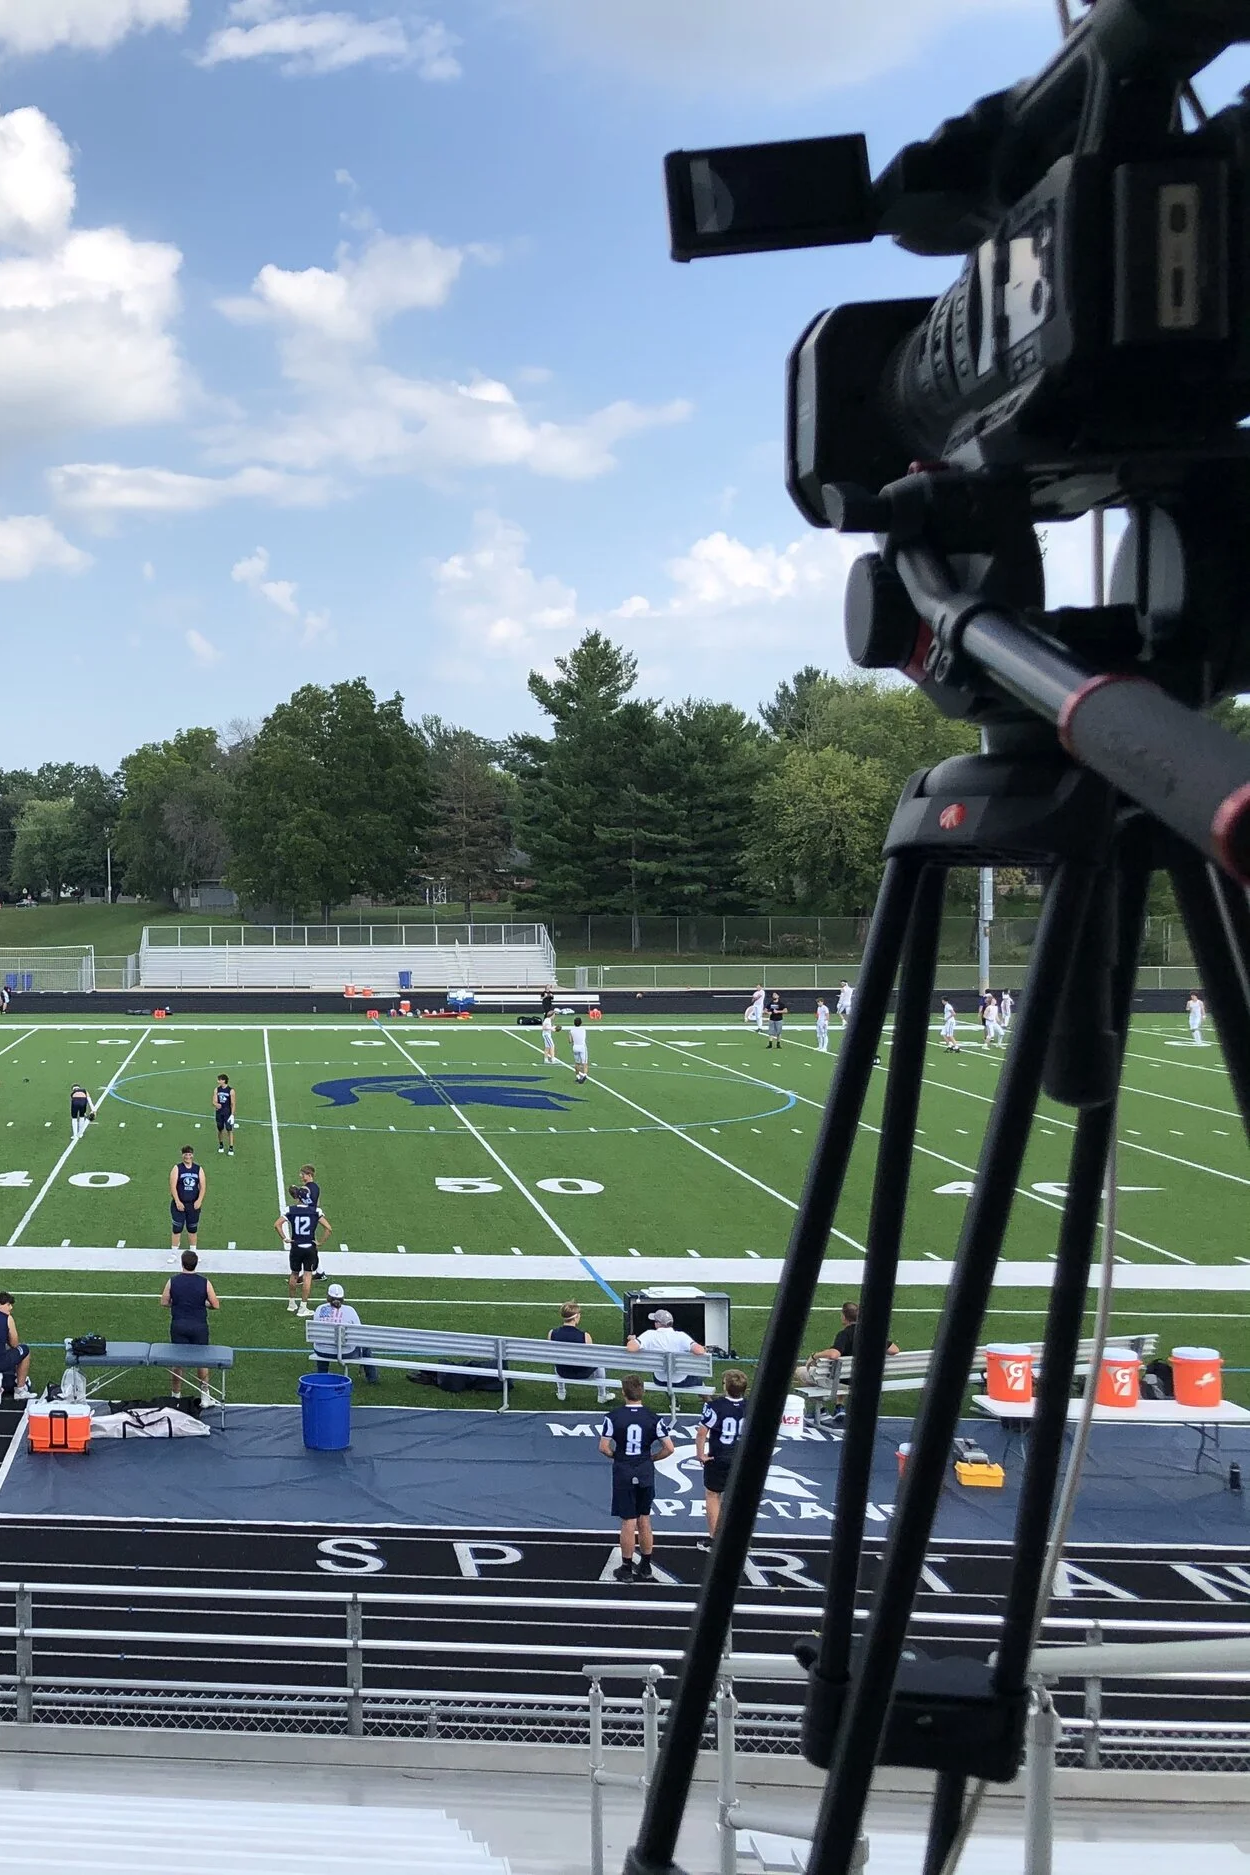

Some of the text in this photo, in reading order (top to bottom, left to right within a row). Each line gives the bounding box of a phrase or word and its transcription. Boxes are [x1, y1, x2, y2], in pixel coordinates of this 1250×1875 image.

[435, 1176, 605, 1194] 50
[294, 1216, 310, 1235] 12
[1009, 1363, 1023, 1378] G
[1116, 1369, 1130, 1384] G
[625, 1424, 642, 1456] 8
